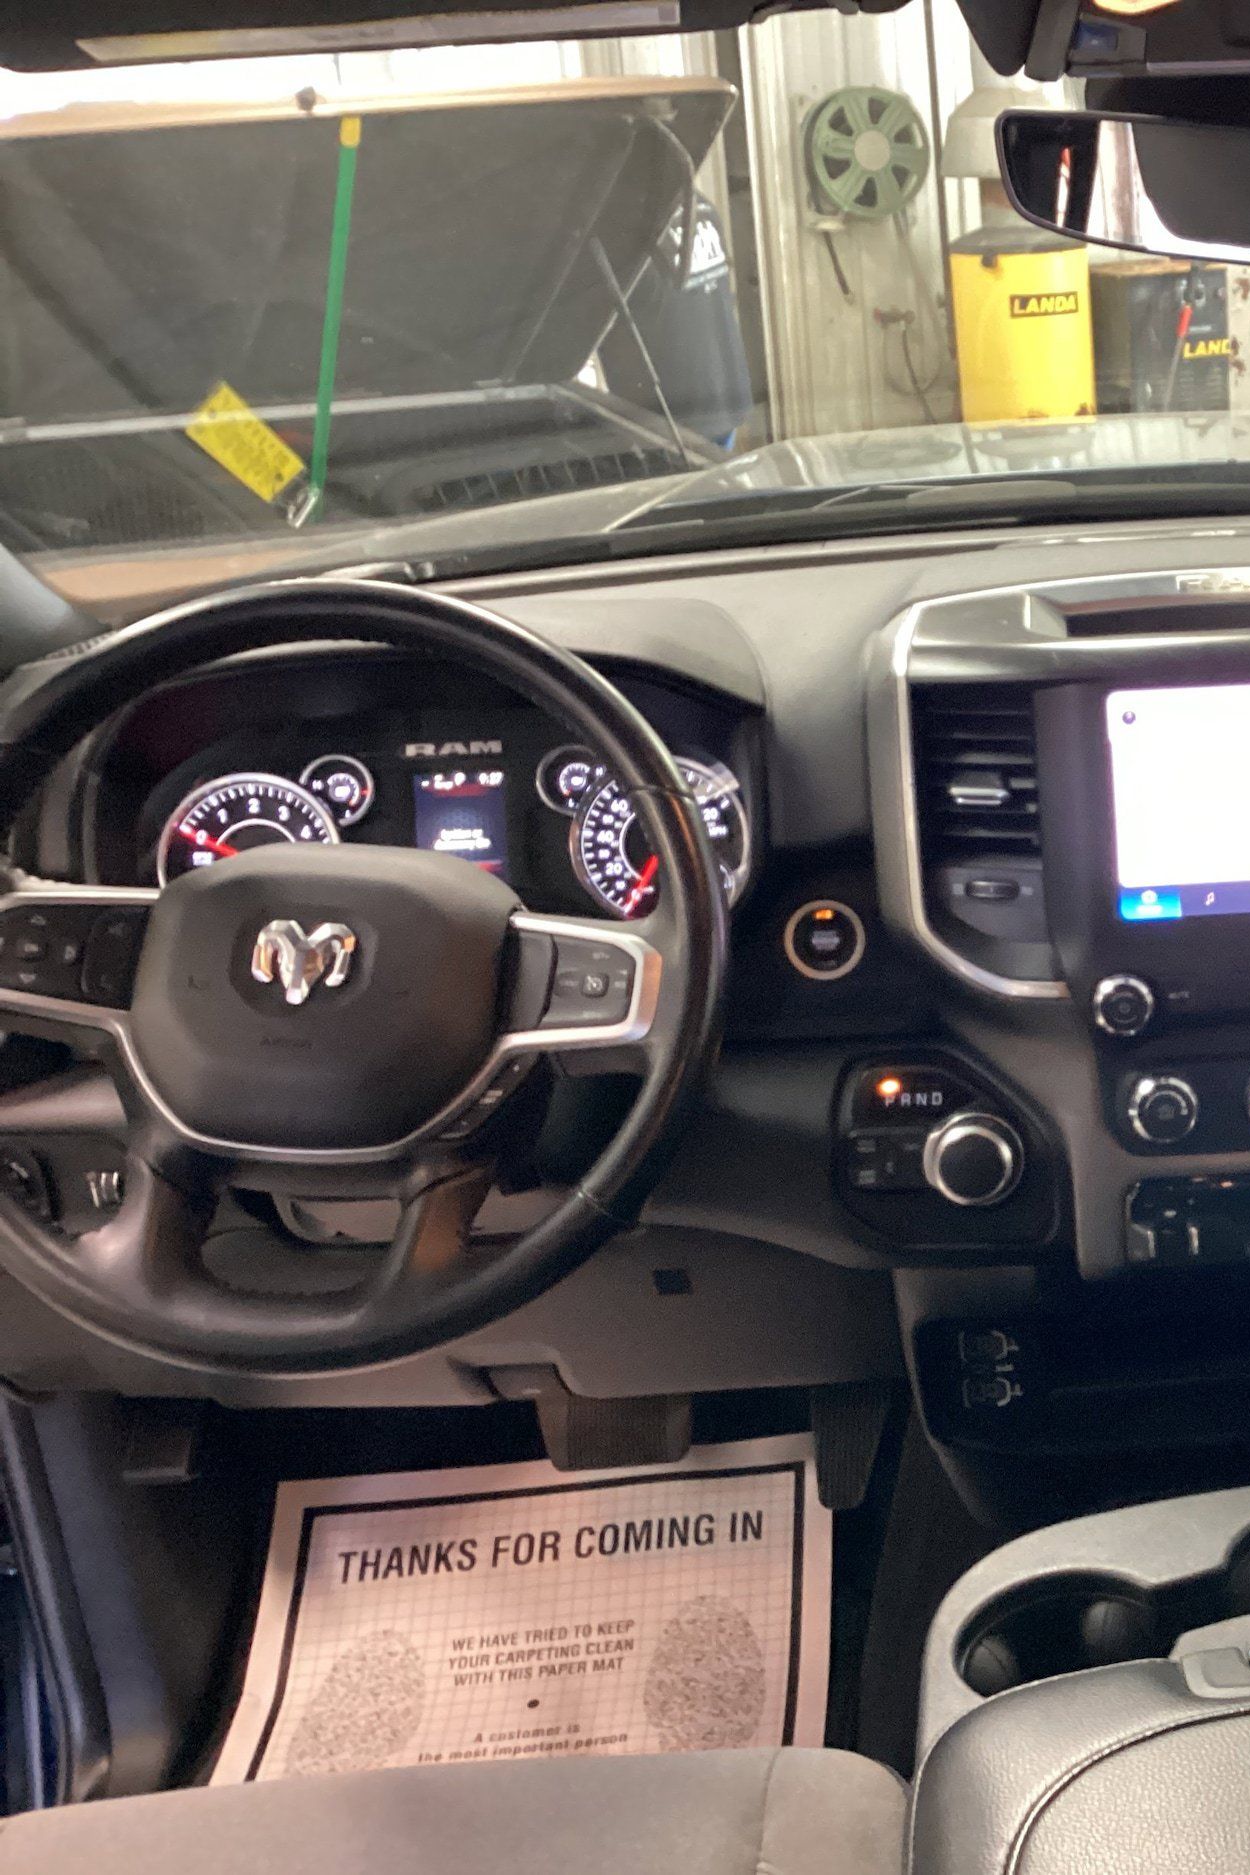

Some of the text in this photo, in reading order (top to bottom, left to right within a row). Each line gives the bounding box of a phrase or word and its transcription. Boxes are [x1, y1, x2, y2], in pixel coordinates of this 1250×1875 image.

[1012, 295, 1077, 315] LANDA
[1183, 338, 1232, 358] LAND
[405, 740, 503, 757] RAM
[248, 798, 260, 814] 2
[611, 800, 628, 813] 60
[301, 825, 312, 840] 4
[597, 830, 615, 844] 40
[605, 862, 622, 876] 20
[338, 1510, 763, 1584] THANKS FOR COMING IN
[452, 1619, 635, 1652] WE HAVE TRIED TO KEEP
[450, 1638, 634, 1670] YOUR CARPETING CLEAN
[454, 1657, 624, 1687] WITH THIS PAPER MAT
[474, 1732, 482, 1743] A
[418, 1733, 628, 1763] the most important person
